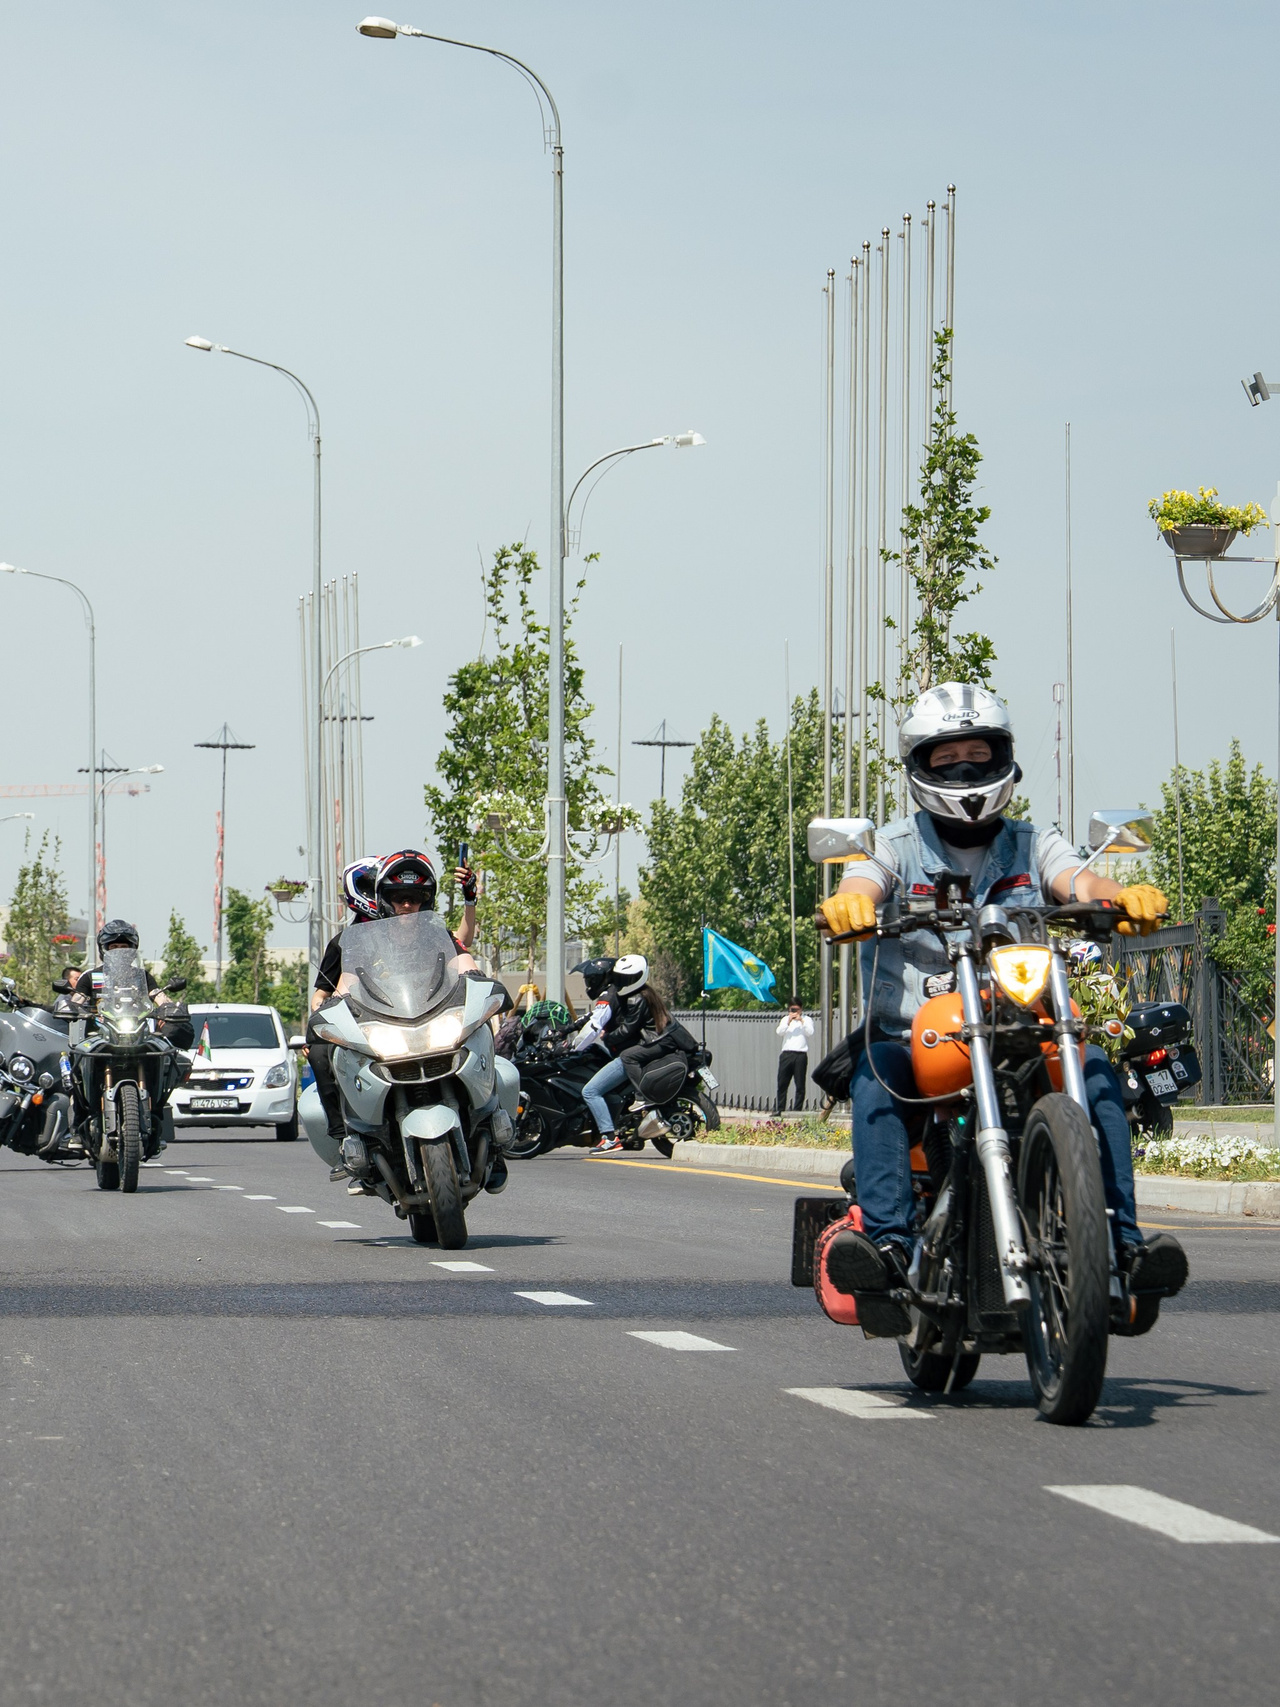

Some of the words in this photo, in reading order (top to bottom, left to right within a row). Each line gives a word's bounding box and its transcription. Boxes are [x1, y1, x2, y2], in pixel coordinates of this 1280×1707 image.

[1157, 1070, 1169, 1081] 17
[1152, 1085, 1164, 1095] 02
[1164, 1082, 1177, 1092] RH
